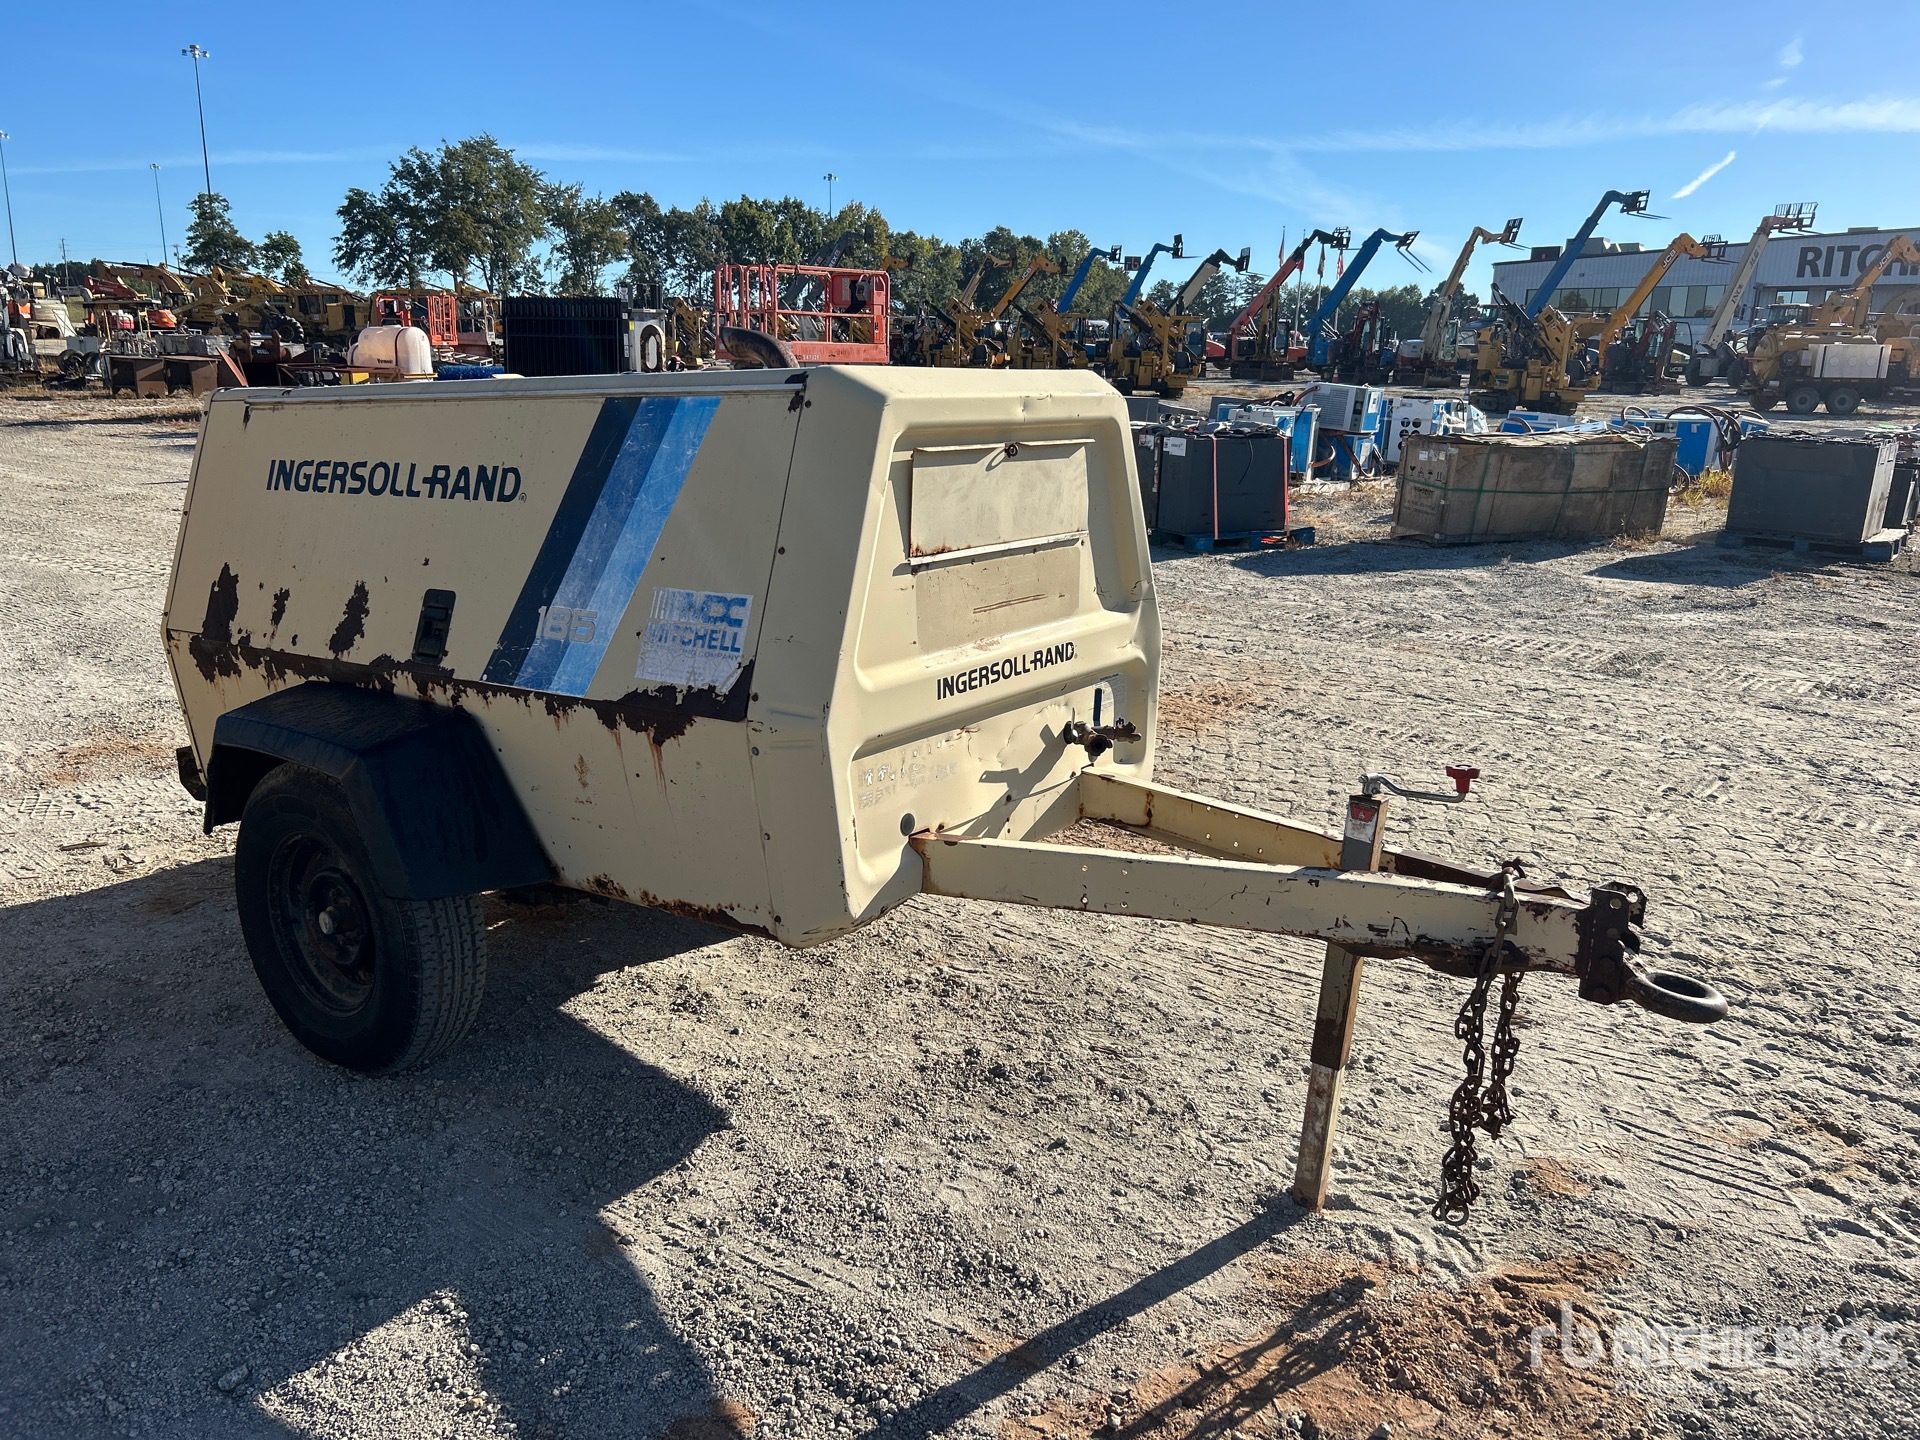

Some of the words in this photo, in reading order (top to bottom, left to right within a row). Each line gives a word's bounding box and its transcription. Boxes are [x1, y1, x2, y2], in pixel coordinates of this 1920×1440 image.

[1661, 249, 1676, 268] JCB
[1878, 250, 1892, 270] JCB
[1021, 267, 1032, 281] JCB
[266, 459, 522, 503] INGERSOLL-RAND
[536, 605, 598, 644] 185
[936, 641, 1075, 701] INGERSOLL-RAND
